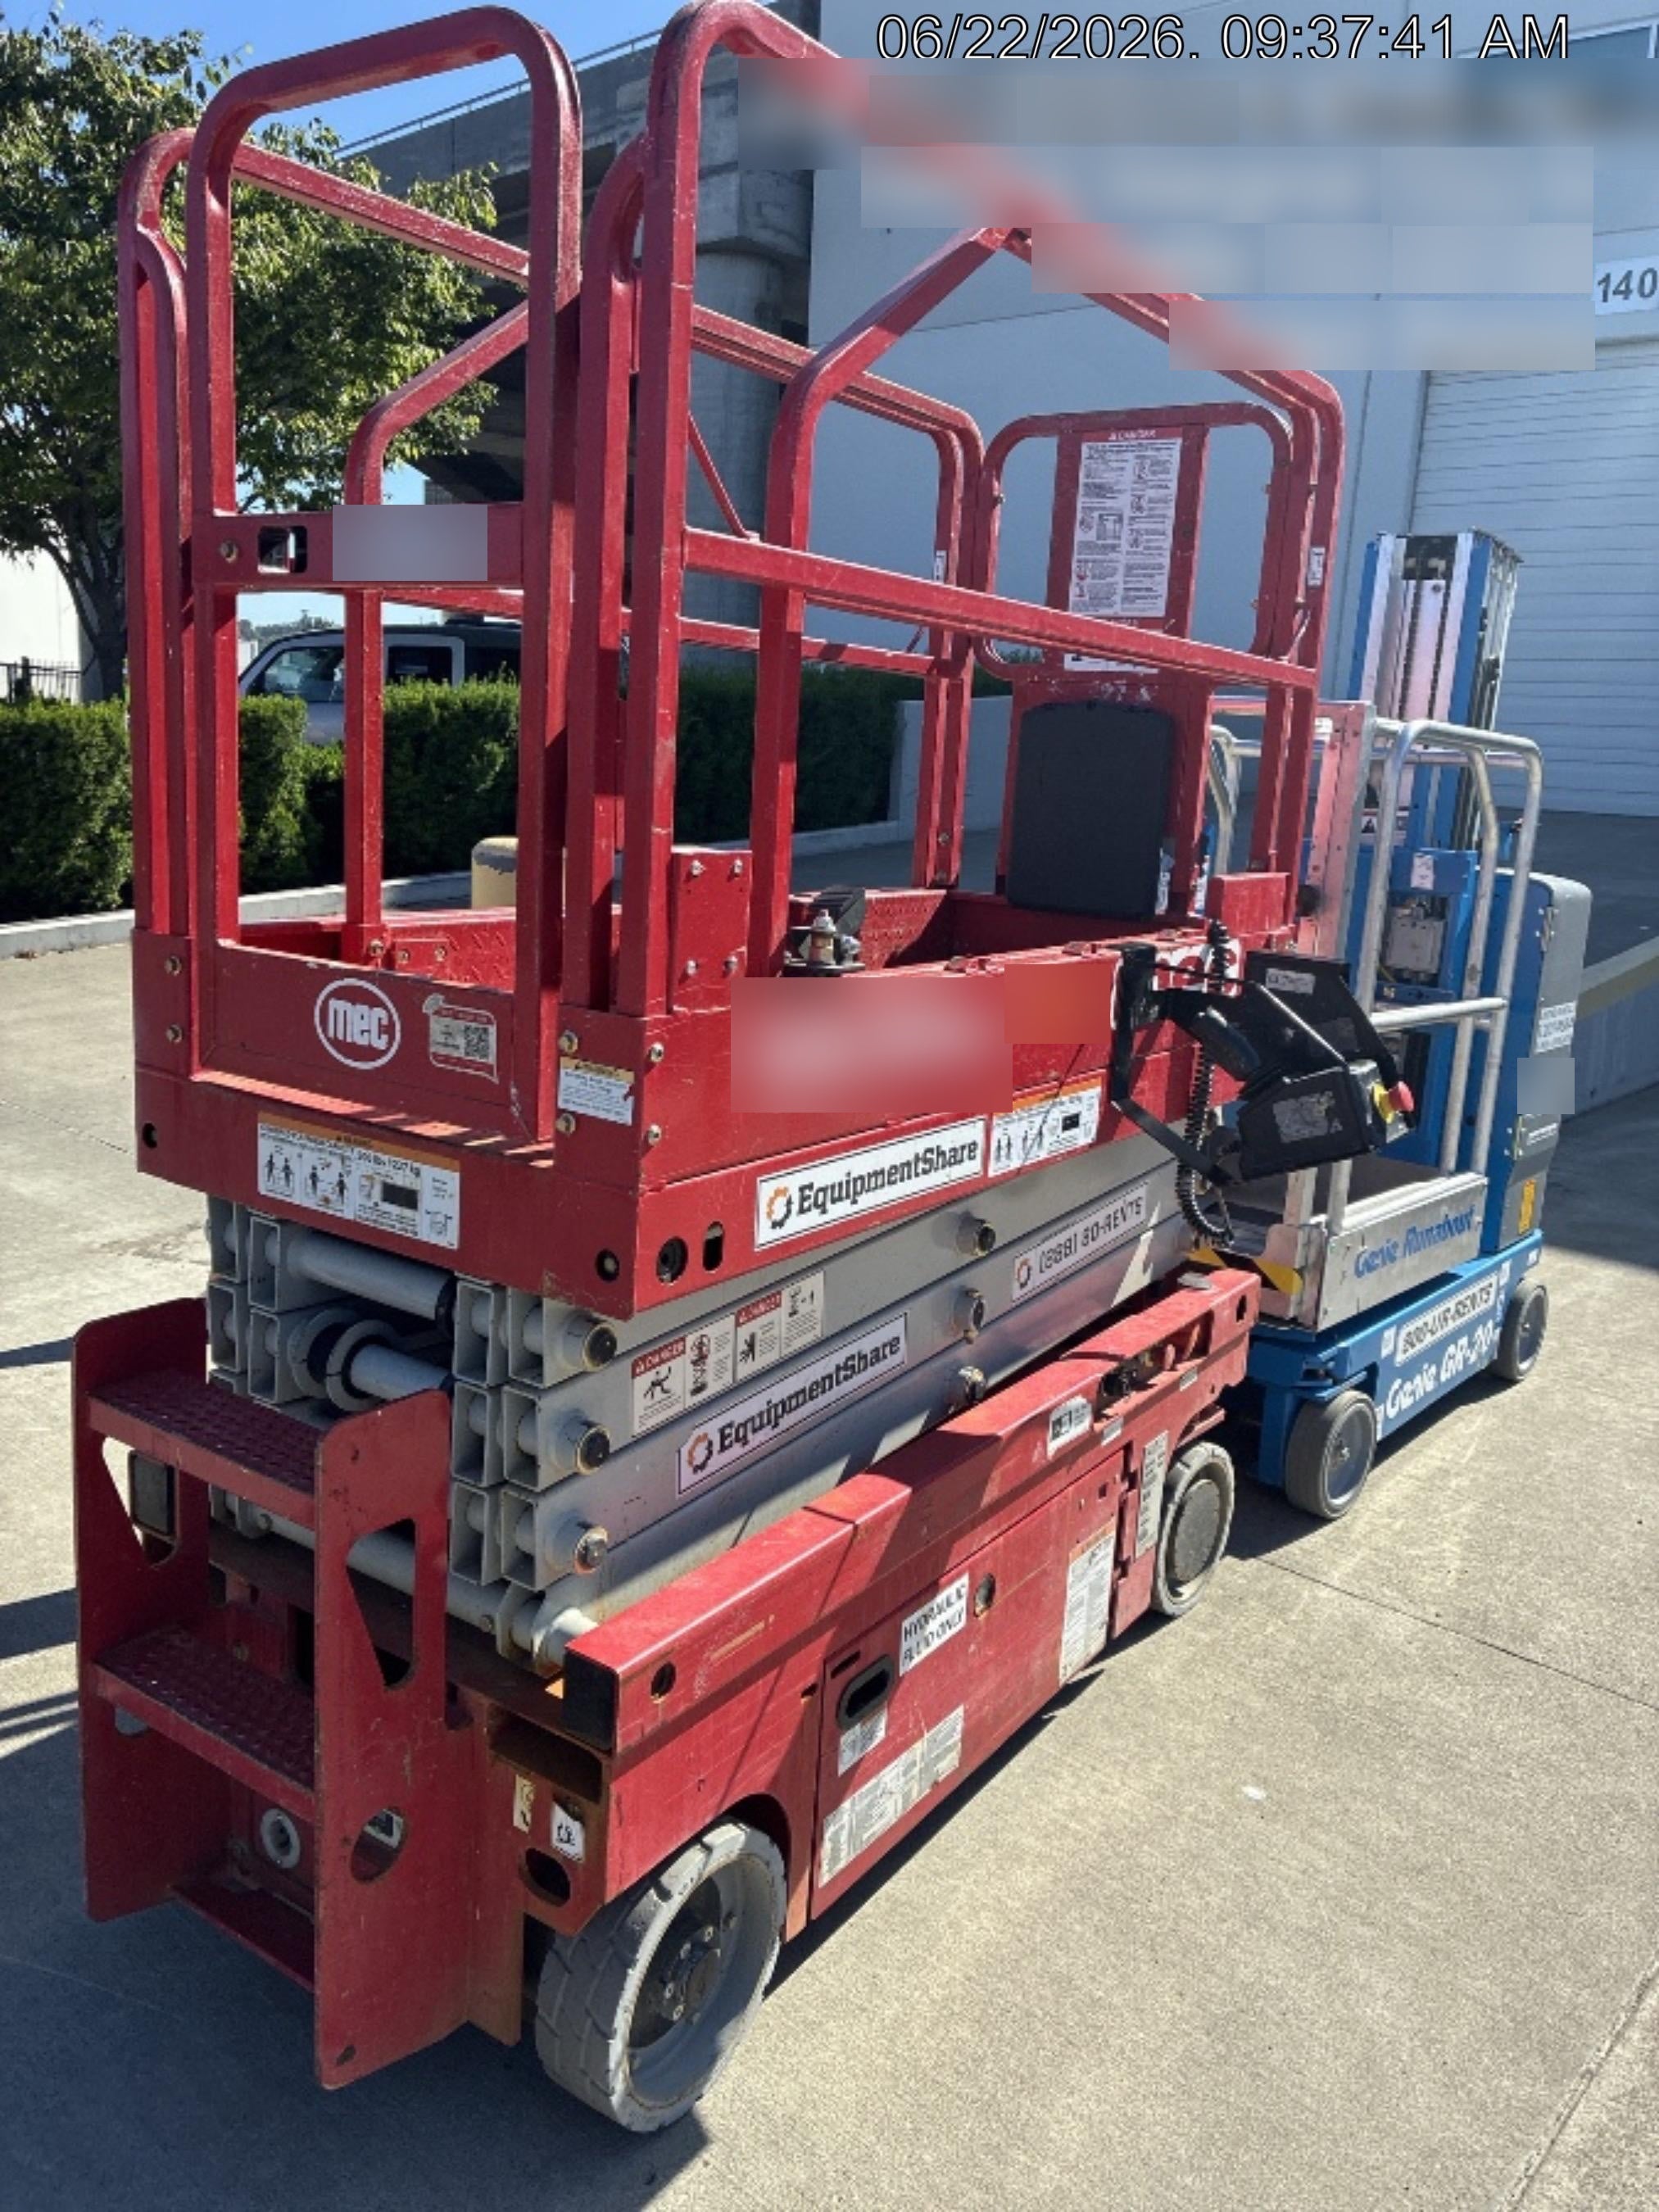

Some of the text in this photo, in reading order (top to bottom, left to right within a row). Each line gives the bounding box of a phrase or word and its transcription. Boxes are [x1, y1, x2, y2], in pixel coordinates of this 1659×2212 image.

[1598, 267, 1657, 303] 140
[797, 1137, 978, 1216] EquipmentShare
[718, 1335, 901, 1454] EquipmentShare
[1386, 1362, 1437, 1419] Genie
